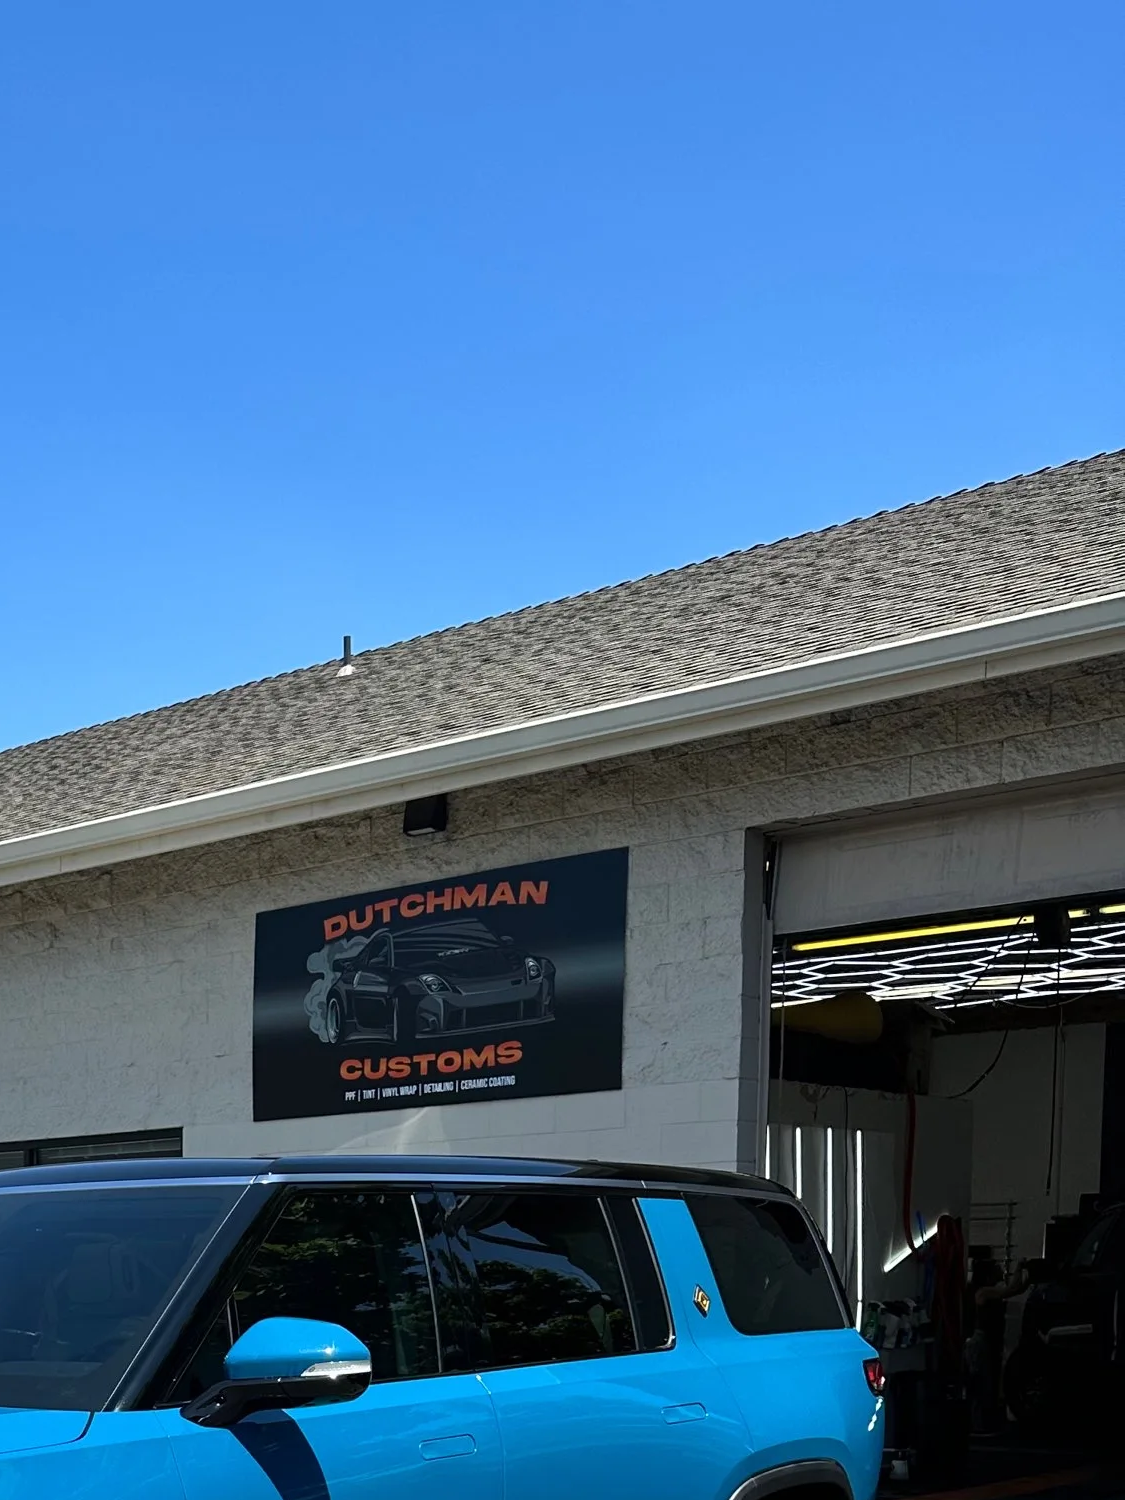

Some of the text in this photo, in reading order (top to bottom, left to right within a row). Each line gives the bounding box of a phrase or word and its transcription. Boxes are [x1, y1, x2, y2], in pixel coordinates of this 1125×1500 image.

[324, 881, 549, 940] DUTCHMAN
[339, 1040, 523, 1081] CUSTOMS
[345, 1090, 356, 1101] PPF
[363, 1089, 376, 1100] TINT
[382, 1087, 399, 1098] VINYL
[400, 1085, 417, 1096] WRAP
[423, 1081, 454, 1094] DETAILING
[460, 1078, 488, 1090] CERAMIC
[488, 1075, 516, 1088] COATING
